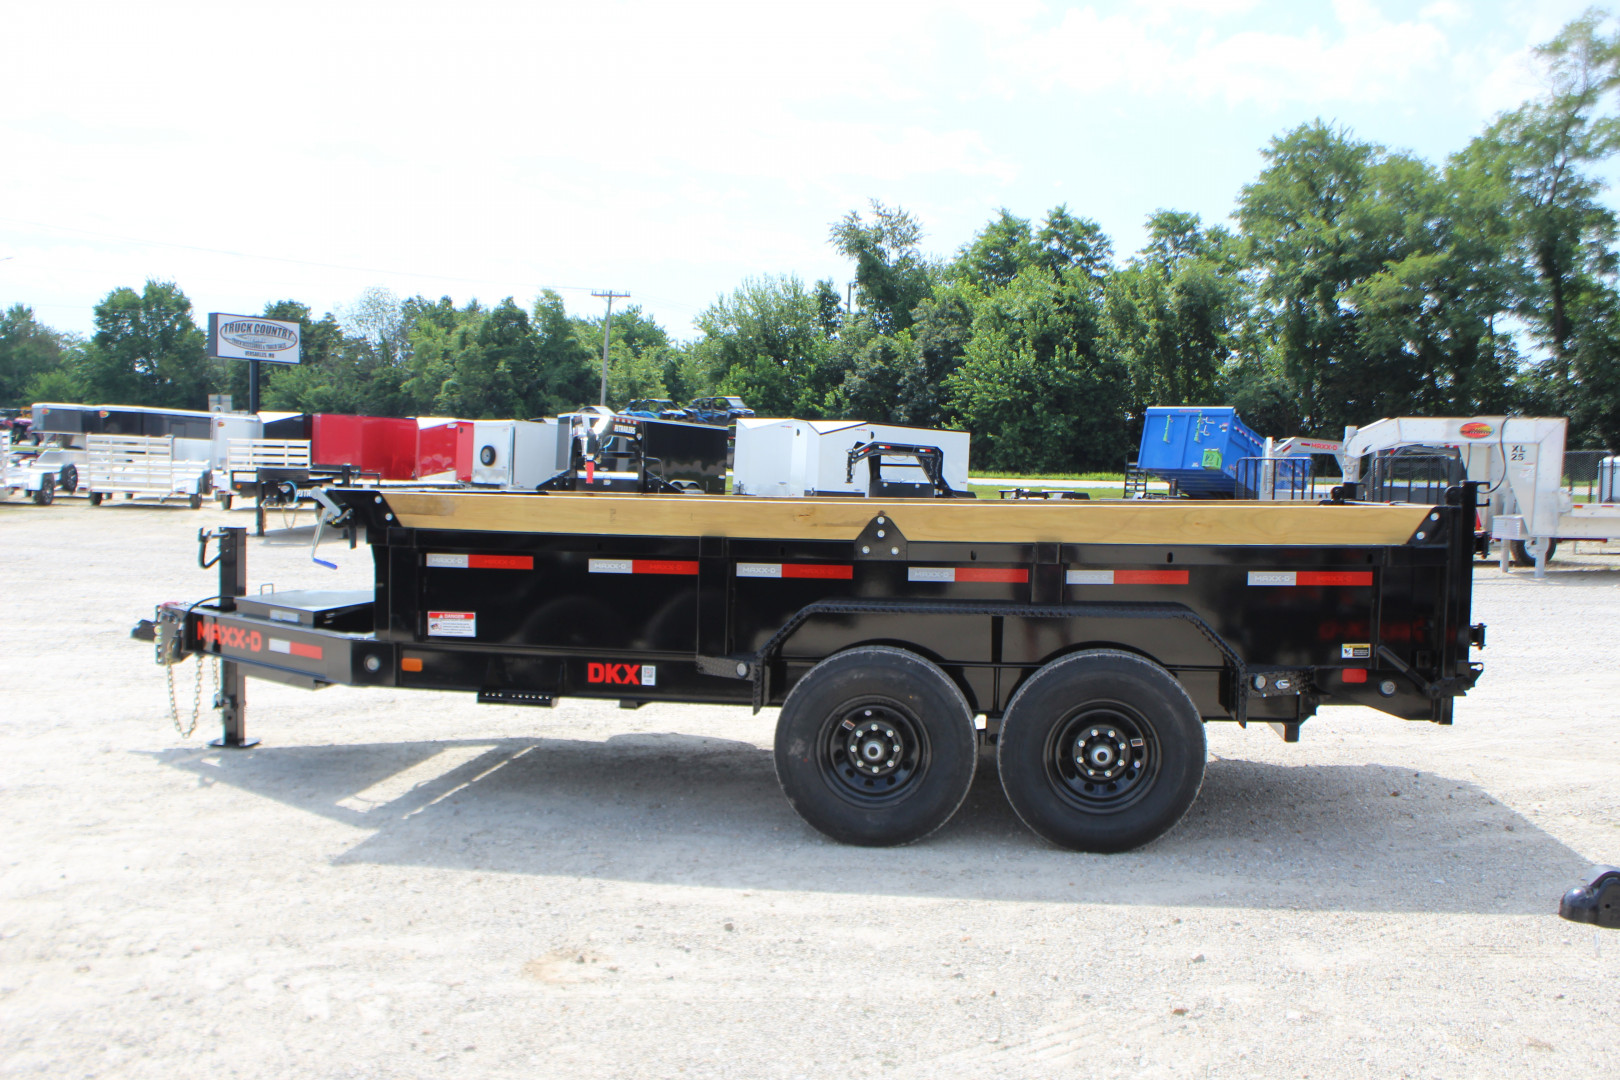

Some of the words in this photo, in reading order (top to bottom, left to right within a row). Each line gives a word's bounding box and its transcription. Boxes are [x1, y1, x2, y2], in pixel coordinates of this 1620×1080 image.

[224, 322, 252, 334] TRUCK
[254, 324, 293, 339] COUNTRY
[1510, 453, 1524, 461] 25
[1511, 445, 1526, 453] XL
[197, 621, 262, 652] MAXX-D
[587, 662, 640, 685] DKX
